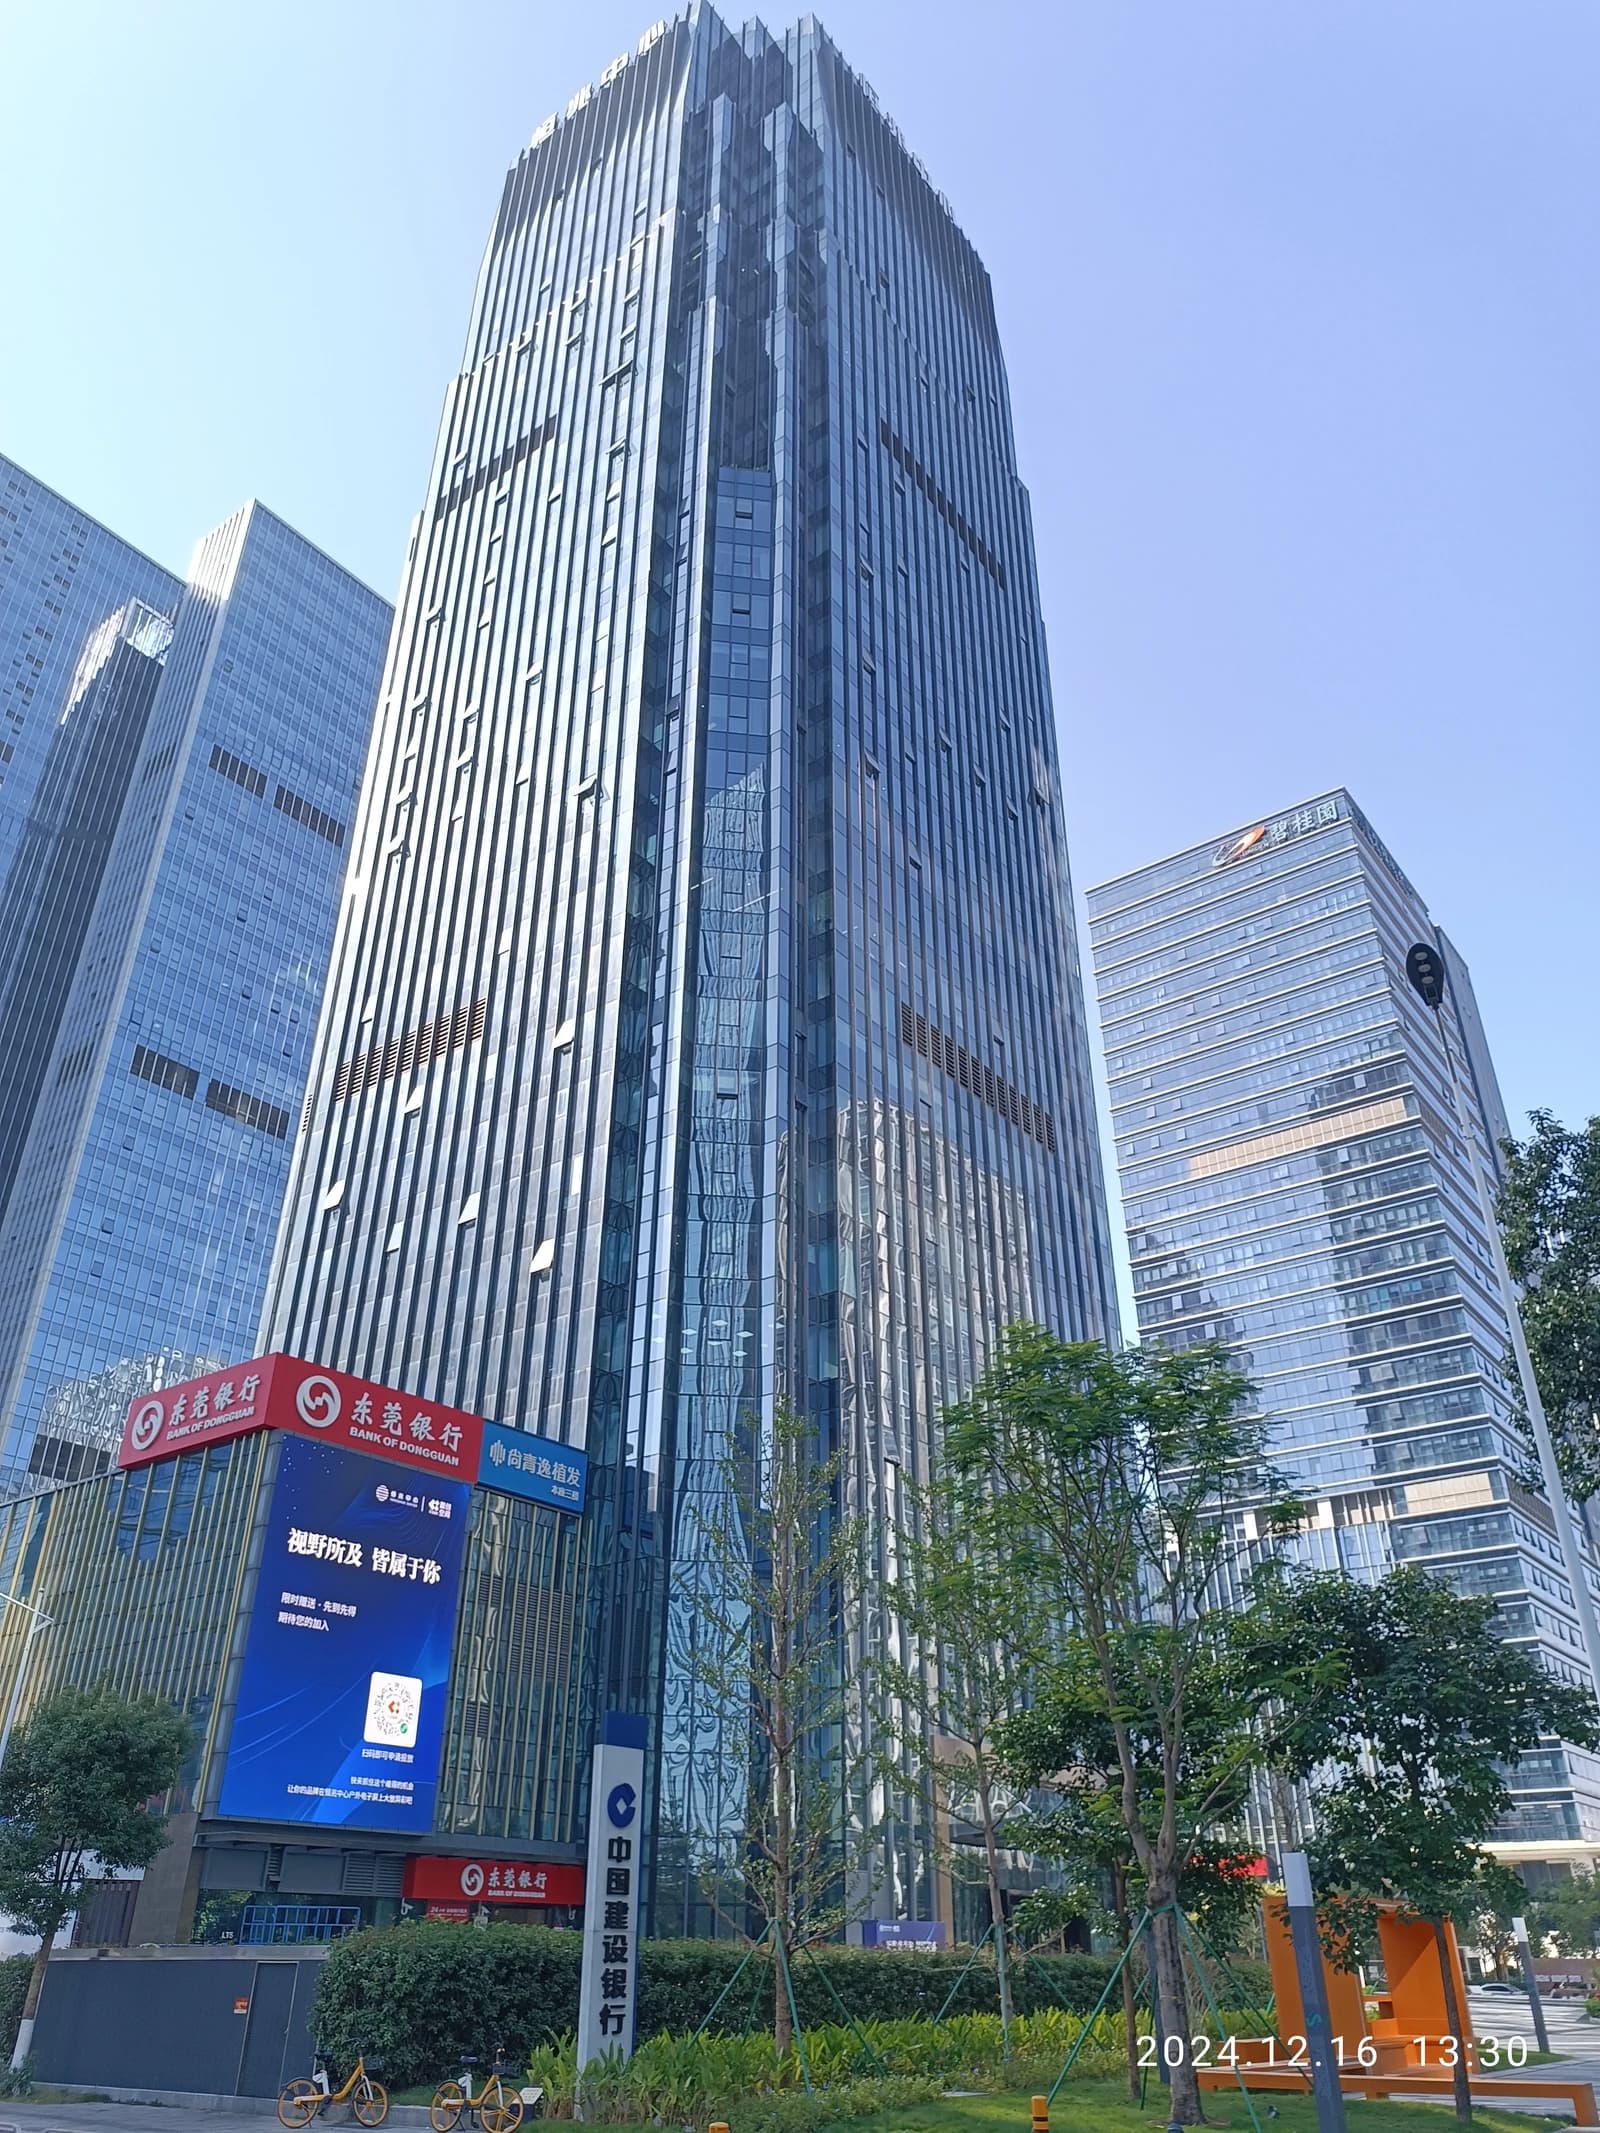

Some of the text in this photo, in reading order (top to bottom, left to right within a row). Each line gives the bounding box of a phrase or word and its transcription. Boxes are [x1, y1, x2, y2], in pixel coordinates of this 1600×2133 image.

[169, 1374, 260, 1426] 东莞银行
[351, 1392, 463, 1452] 东莞银行
[166, 1406, 255, 1441] BANK OF DONGGUAN
[350, 1426, 459, 1466] BANK OF DONGGUAN
[287, 1527, 442, 1584] 视野所及 皆属于你
[278, 1611, 329, 1631] 期待您的加入
[488, 1866, 547, 1890] 东莞银行
[599, 1836, 632, 2035] 中国建设银行
